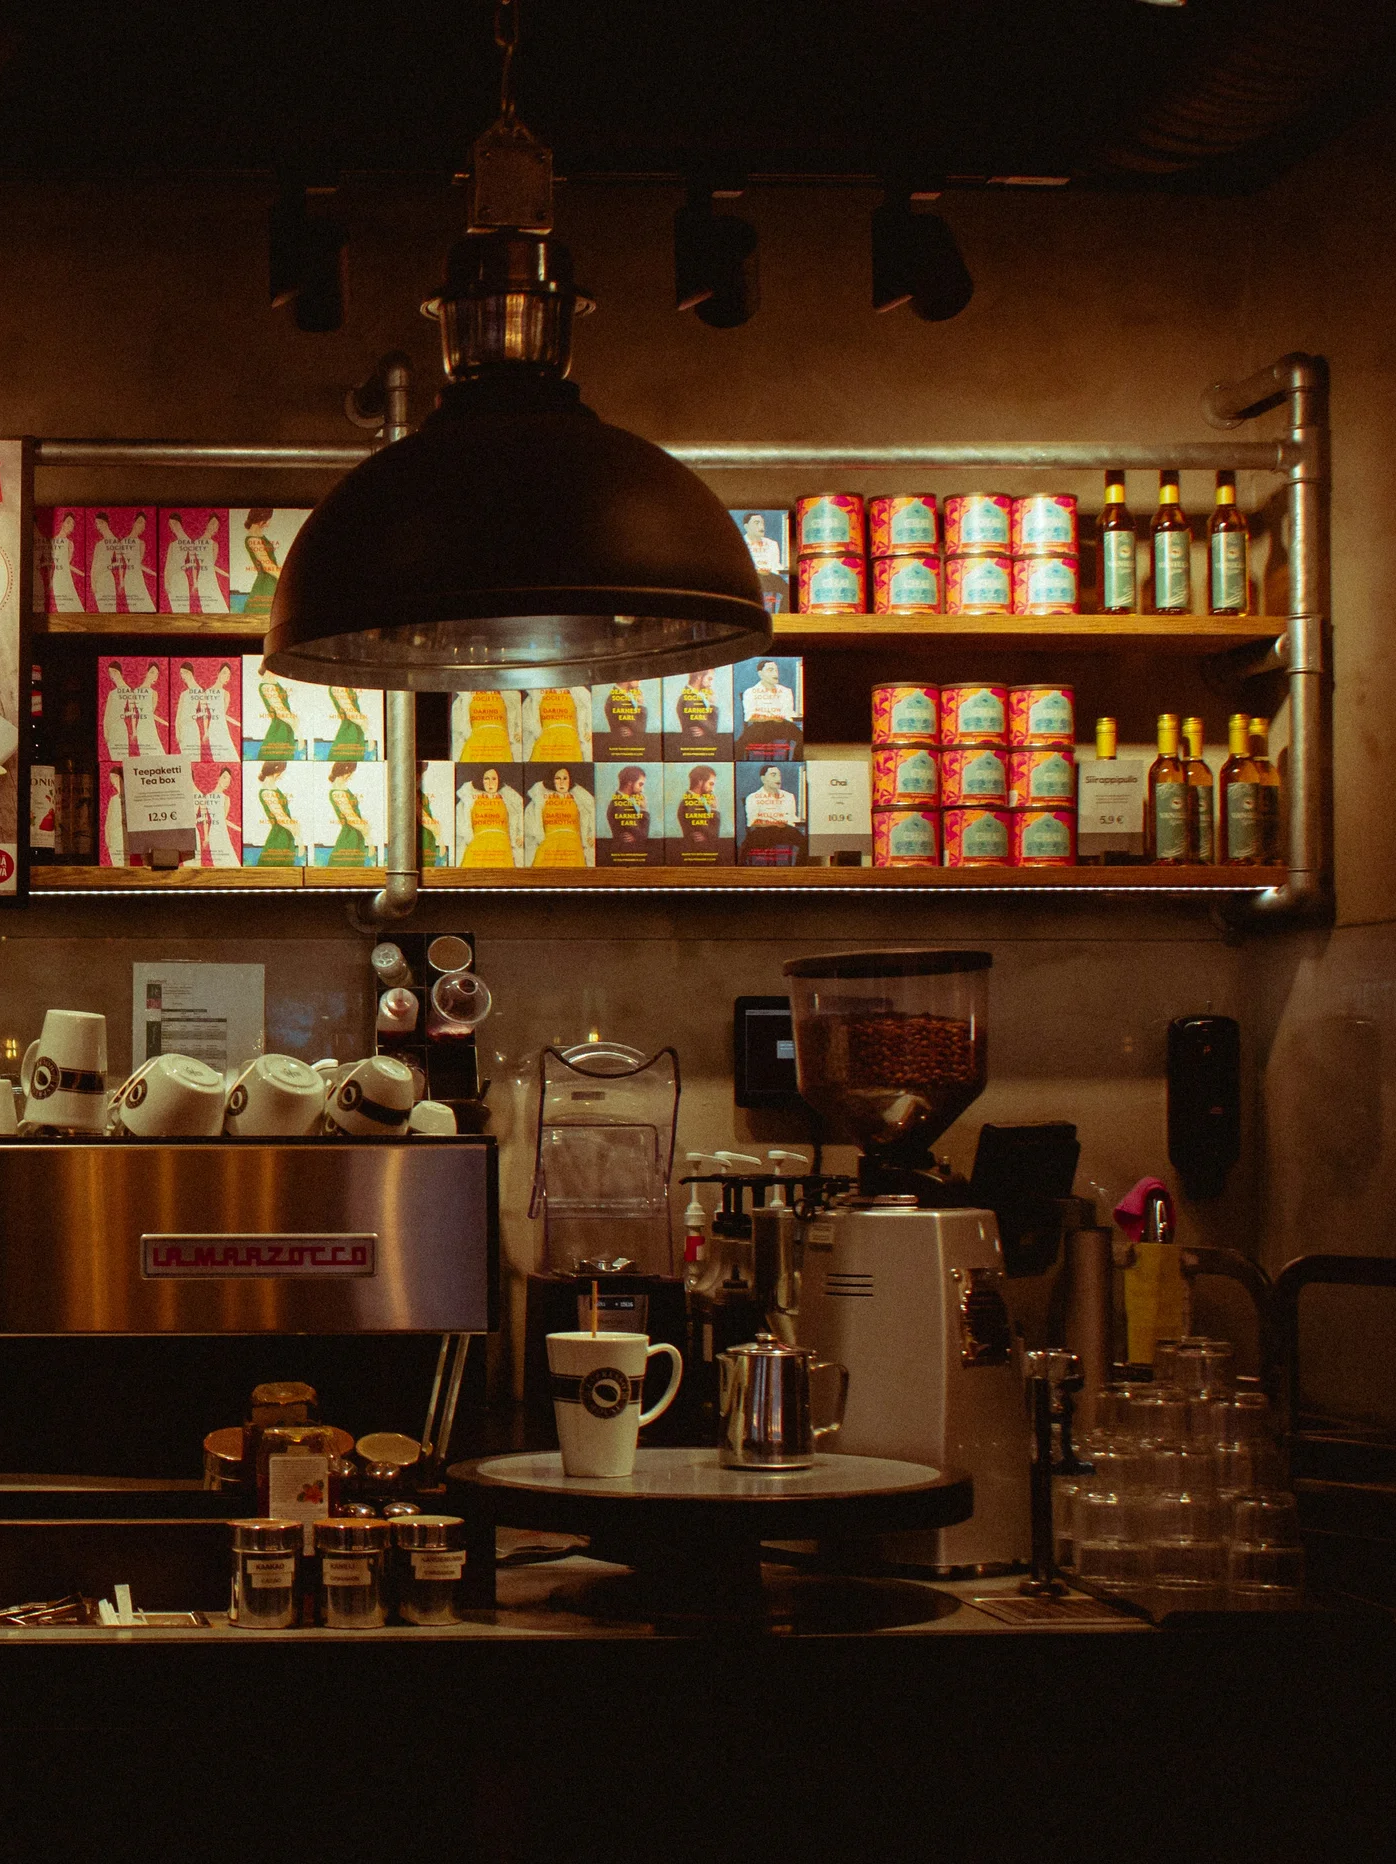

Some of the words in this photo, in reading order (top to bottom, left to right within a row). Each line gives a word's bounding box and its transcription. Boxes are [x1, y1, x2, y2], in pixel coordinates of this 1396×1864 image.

[133, 766, 182, 776] Teepaketti
[31, 778, 54, 787] ONIN
[140, 777, 158, 785] Tea
[159, 776, 176, 784] box
[830, 779, 848, 787] Chai
[1085, 775, 1138, 785] Siirappipullo
[170, 811, 178, 820] €
[1117, 815, 1124, 824] €
